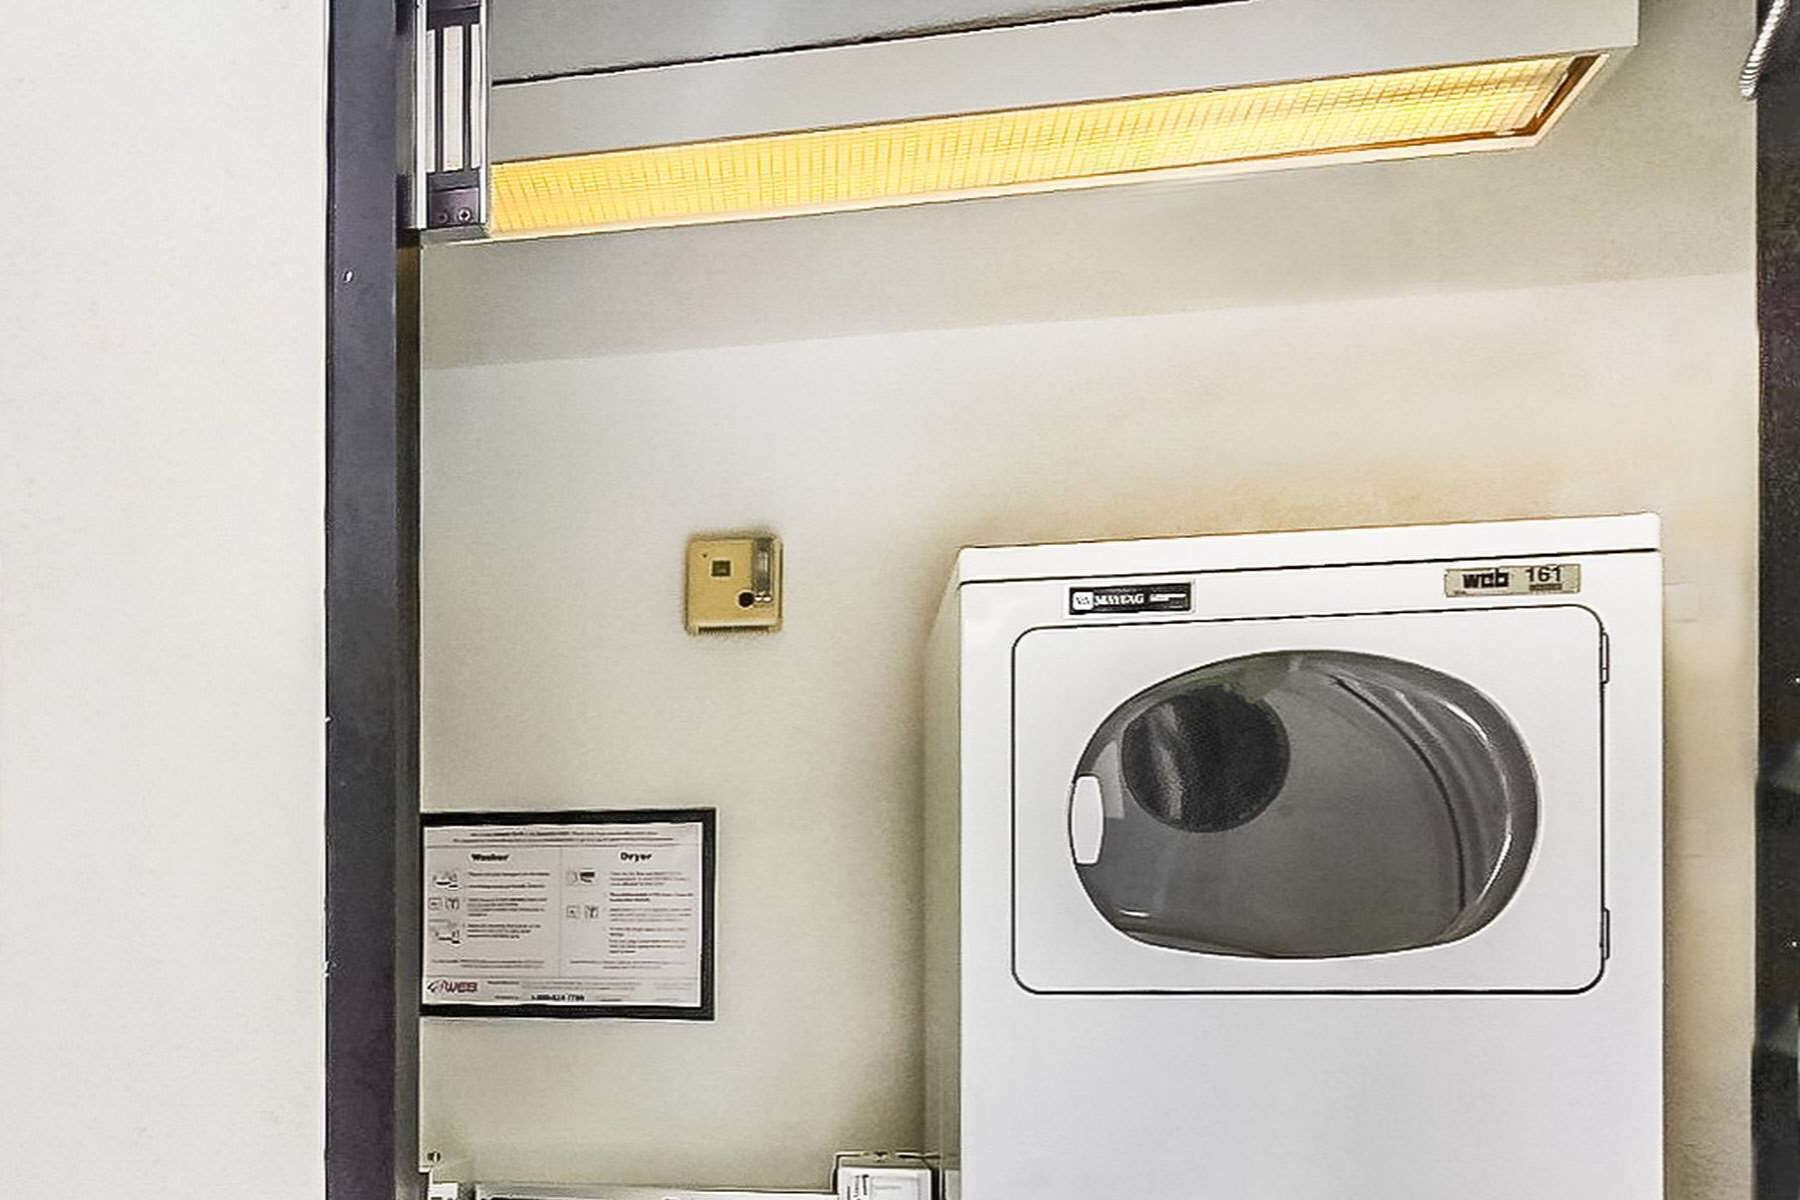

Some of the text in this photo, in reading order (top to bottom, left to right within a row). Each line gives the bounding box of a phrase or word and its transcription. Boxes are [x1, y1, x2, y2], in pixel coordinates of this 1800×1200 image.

[1462, 568, 1510, 588] web
[1526, 566, 1562, 583] 161
[620, 851, 653, 863] Dryer
